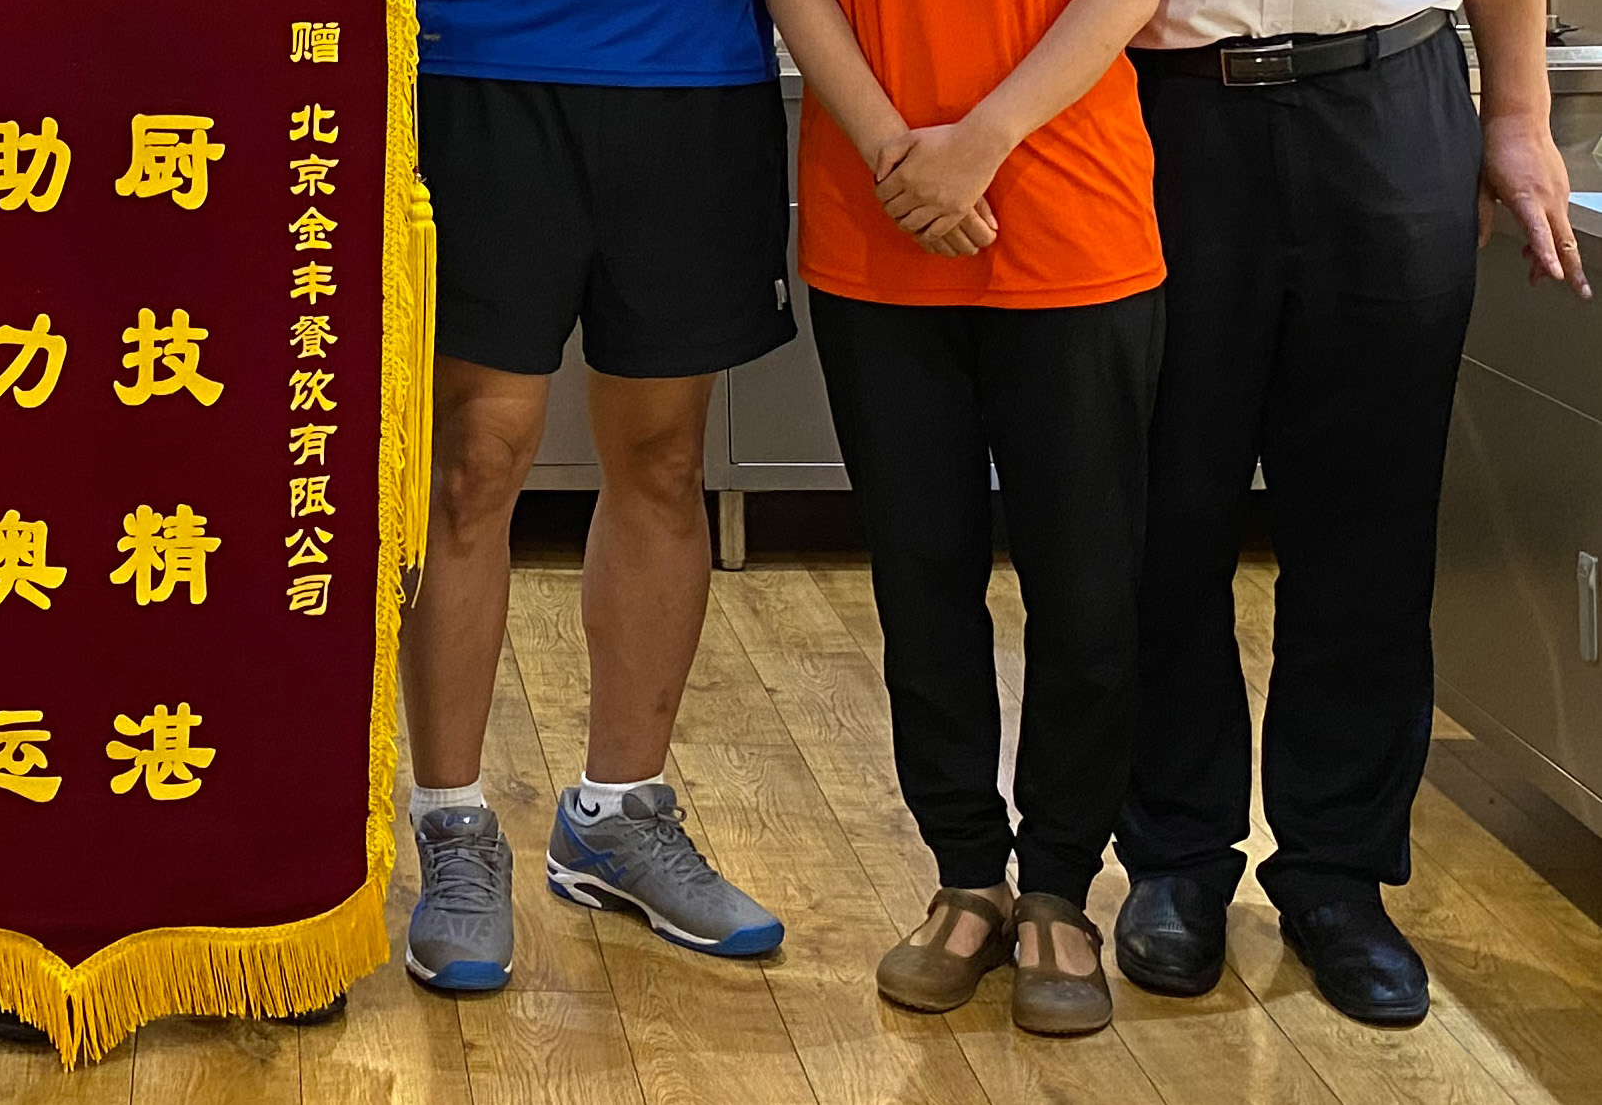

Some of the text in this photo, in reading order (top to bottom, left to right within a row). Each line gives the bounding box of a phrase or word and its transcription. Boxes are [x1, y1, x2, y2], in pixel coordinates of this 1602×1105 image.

[106, 113, 226, 801] 厨技精湛
[284, 20, 340, 617] 赠 北京金丰餐饮有限公司
